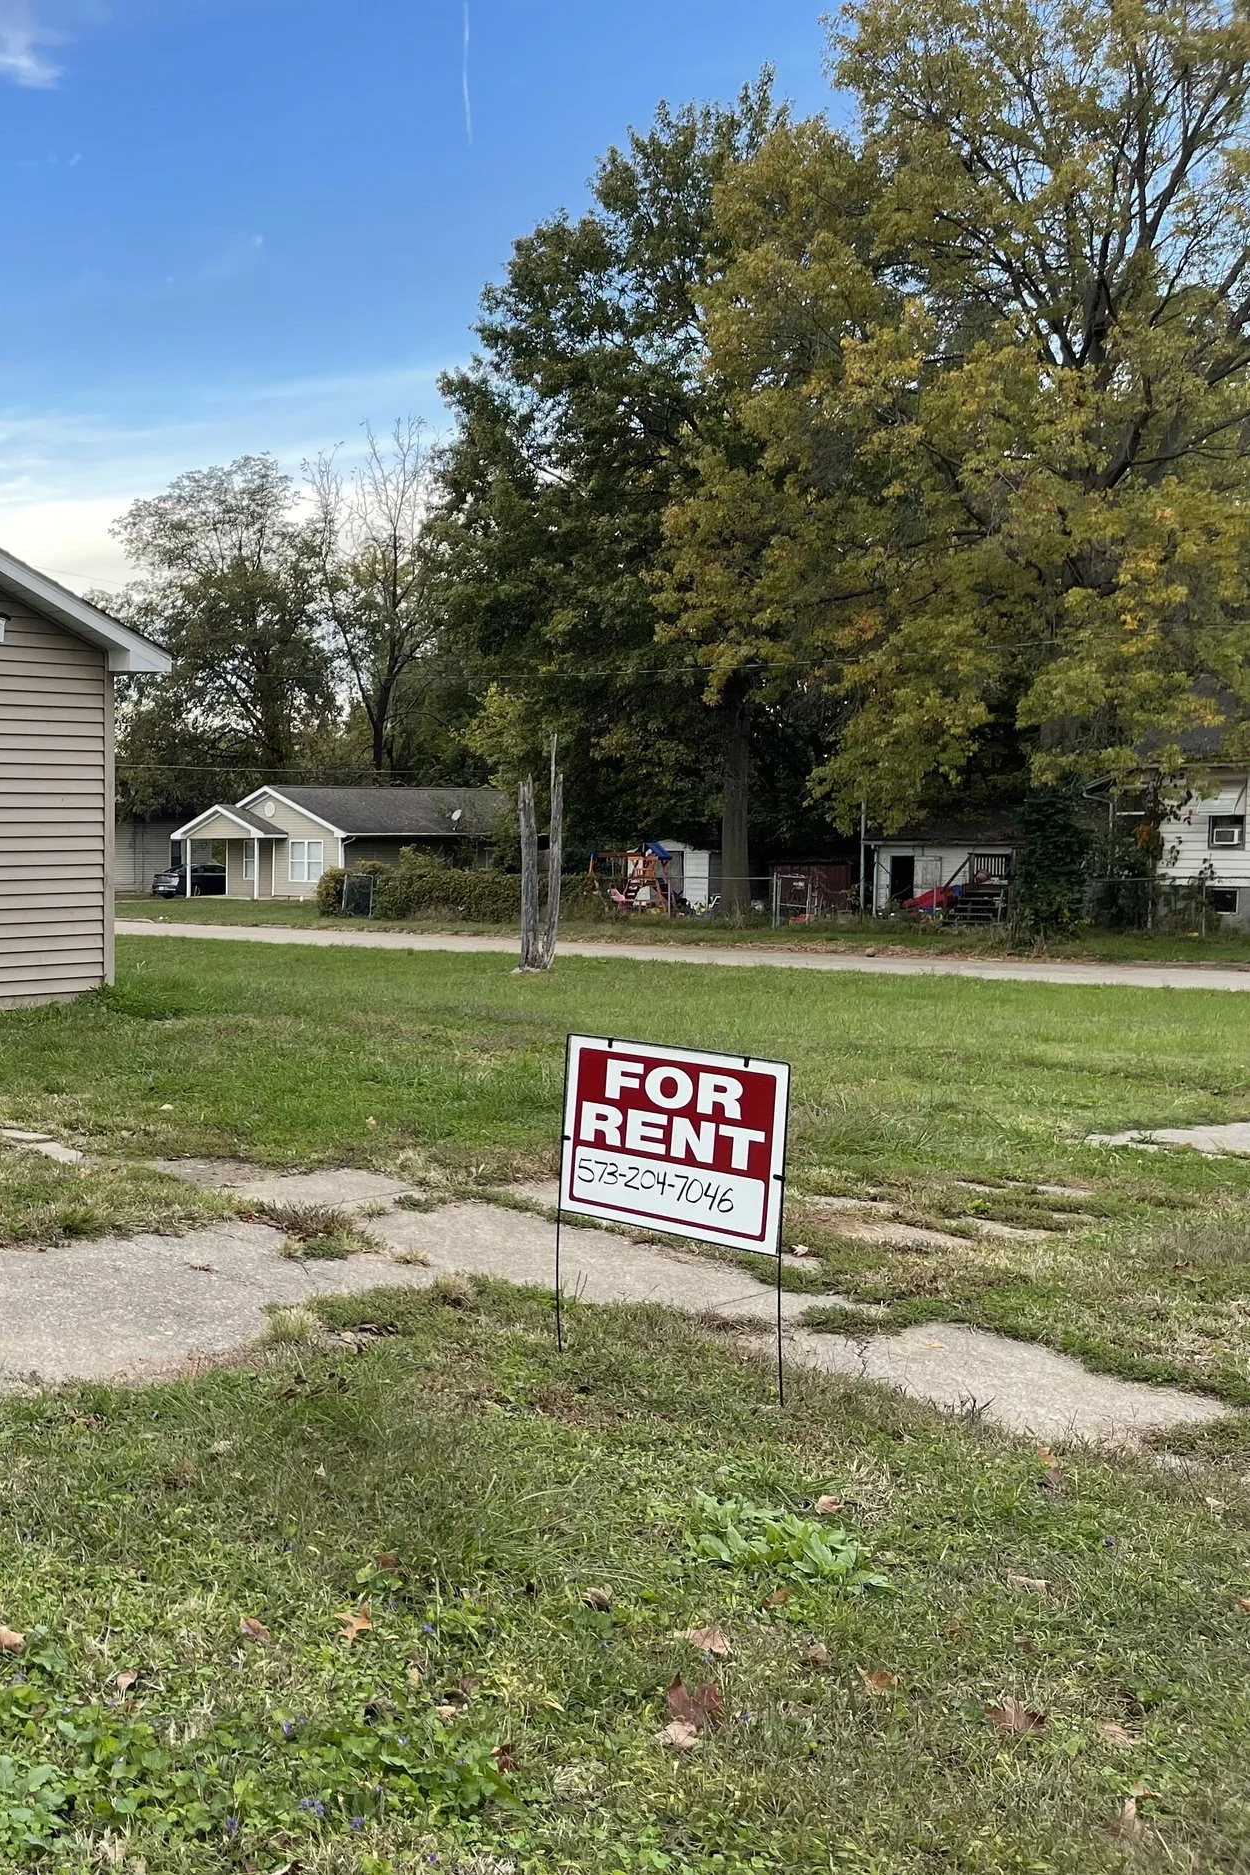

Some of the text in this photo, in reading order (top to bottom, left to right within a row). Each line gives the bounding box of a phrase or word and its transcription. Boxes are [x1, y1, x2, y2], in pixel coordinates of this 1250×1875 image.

[605, 1058, 743, 1120] FOR
[579, 1100, 765, 1171] RENT
[577, 1158, 734, 1213] 573-204-7046
